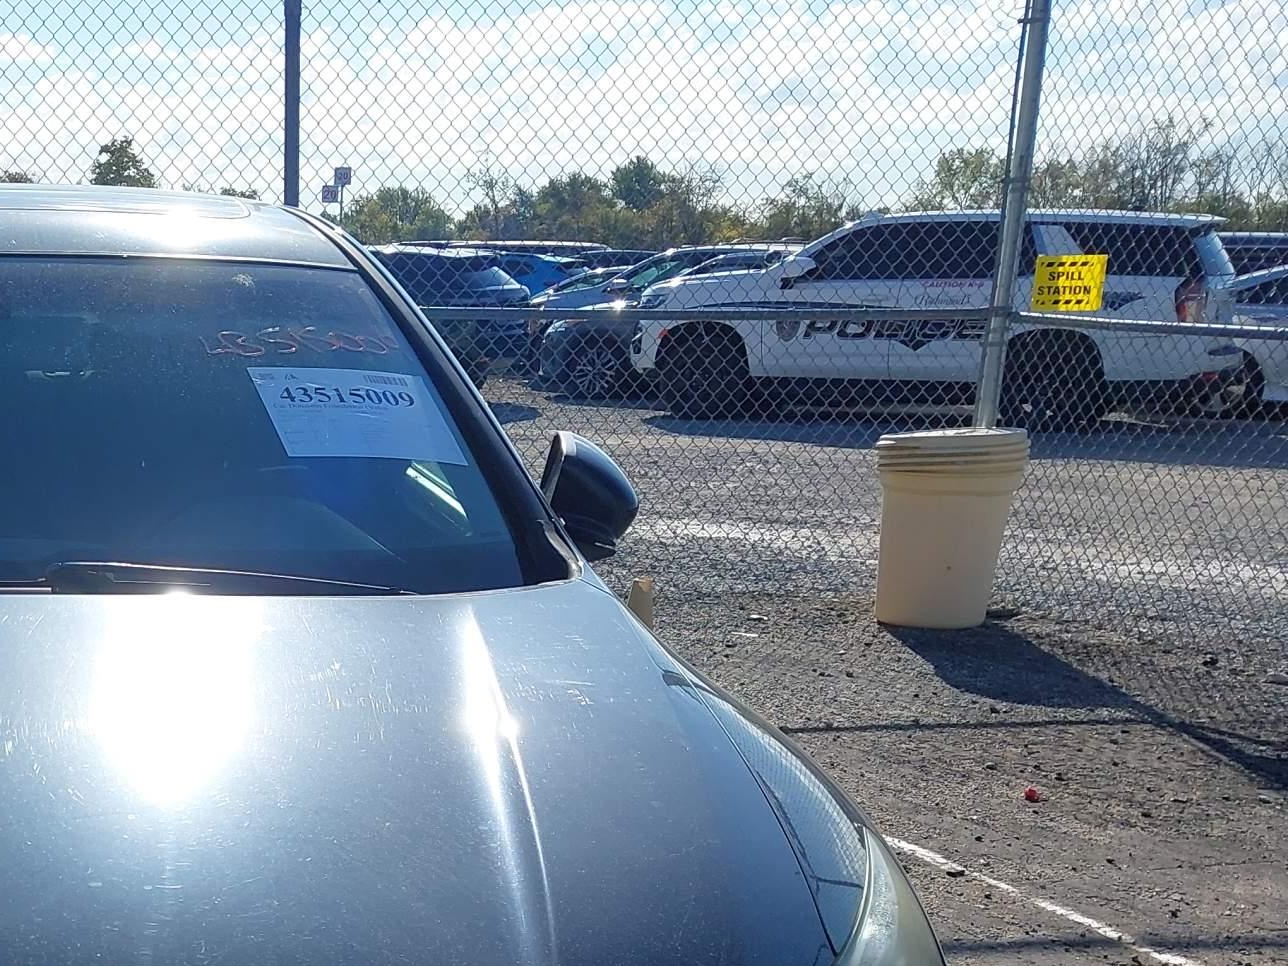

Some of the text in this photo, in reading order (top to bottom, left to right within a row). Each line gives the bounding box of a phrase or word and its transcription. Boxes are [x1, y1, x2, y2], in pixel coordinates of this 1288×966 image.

[1048, 271, 1085, 282] SPILL
[1037, 285, 1092, 296] STATION
[279, 386, 415, 408] 43515009
